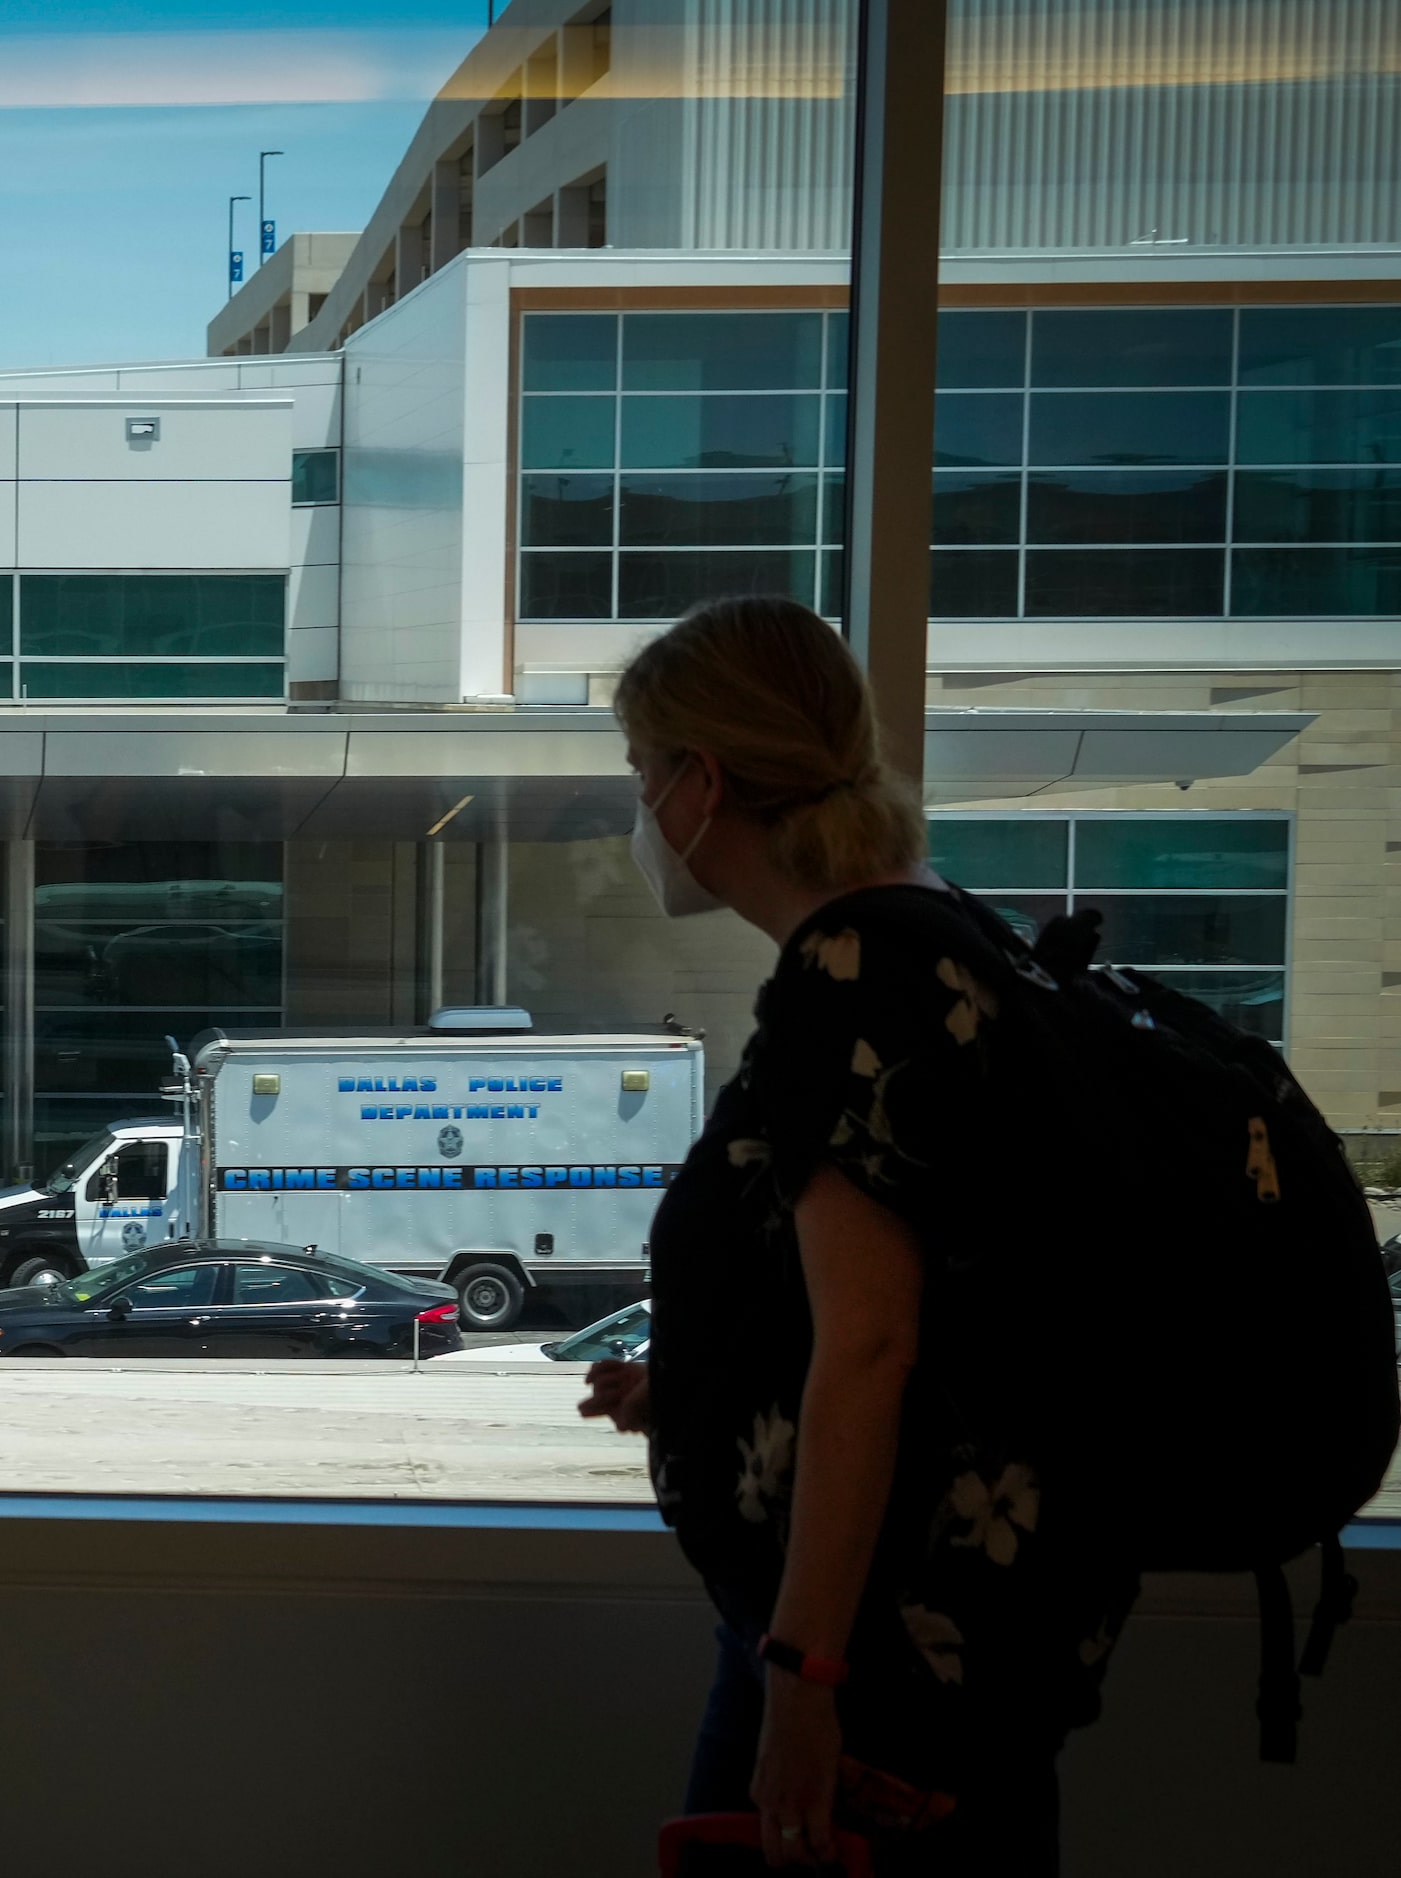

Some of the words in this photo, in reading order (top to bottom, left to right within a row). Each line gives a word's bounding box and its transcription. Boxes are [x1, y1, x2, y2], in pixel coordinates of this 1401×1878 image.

[338, 1075, 437, 1093] DALLAS
[468, 1075, 564, 1093] POLICE
[360, 1103, 541, 1121] DEPARTMENT
[223, 1167, 338, 1190] CRIME
[347, 1167, 464, 1190] SCENE
[473, 1165, 664, 1188] RESPONSE
[37, 1209, 76, 1220] 2167
[99, 1206, 163, 1219] DALLAS
